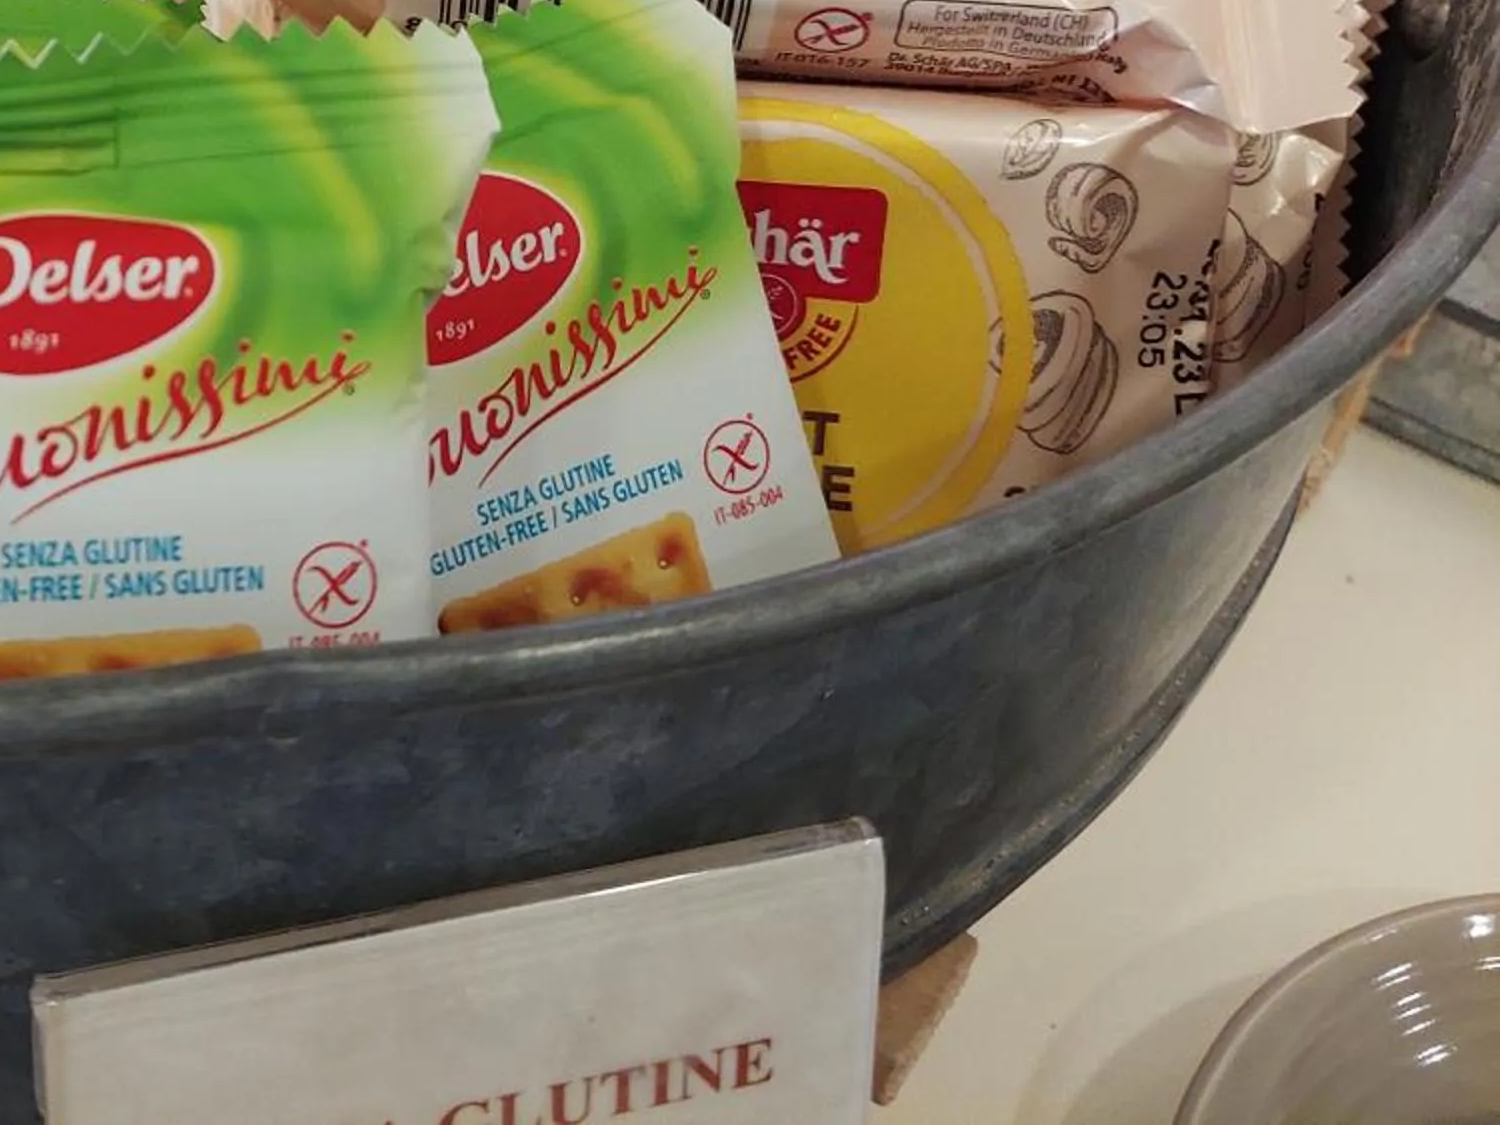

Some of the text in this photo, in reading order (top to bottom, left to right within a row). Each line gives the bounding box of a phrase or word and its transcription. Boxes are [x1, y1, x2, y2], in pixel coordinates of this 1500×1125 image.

[934, 5, 960, 22] For
[443, 220, 567, 299] elser
[754, 208, 862, 285] här
[9, 329, 60, 355] 1891
[435, 318, 477, 342] 1891
[783, 312, 842, 371] FREE
[1137, 270, 1188, 369] 23:05
[427, 244, 718, 489] uonissimi
[429, 511, 549, 577] GLUTEN-FREE
[565, 487, 611, 524] SANS
[612, 459, 685, 503] GLUTEN
[476, 454, 617, 527] SENZA GLUTINE
[0, 535, 183, 569] SENZA GLUTINE
[104, 569, 169, 600] SANS
[173, 565, 265, 597] GLUTEN
